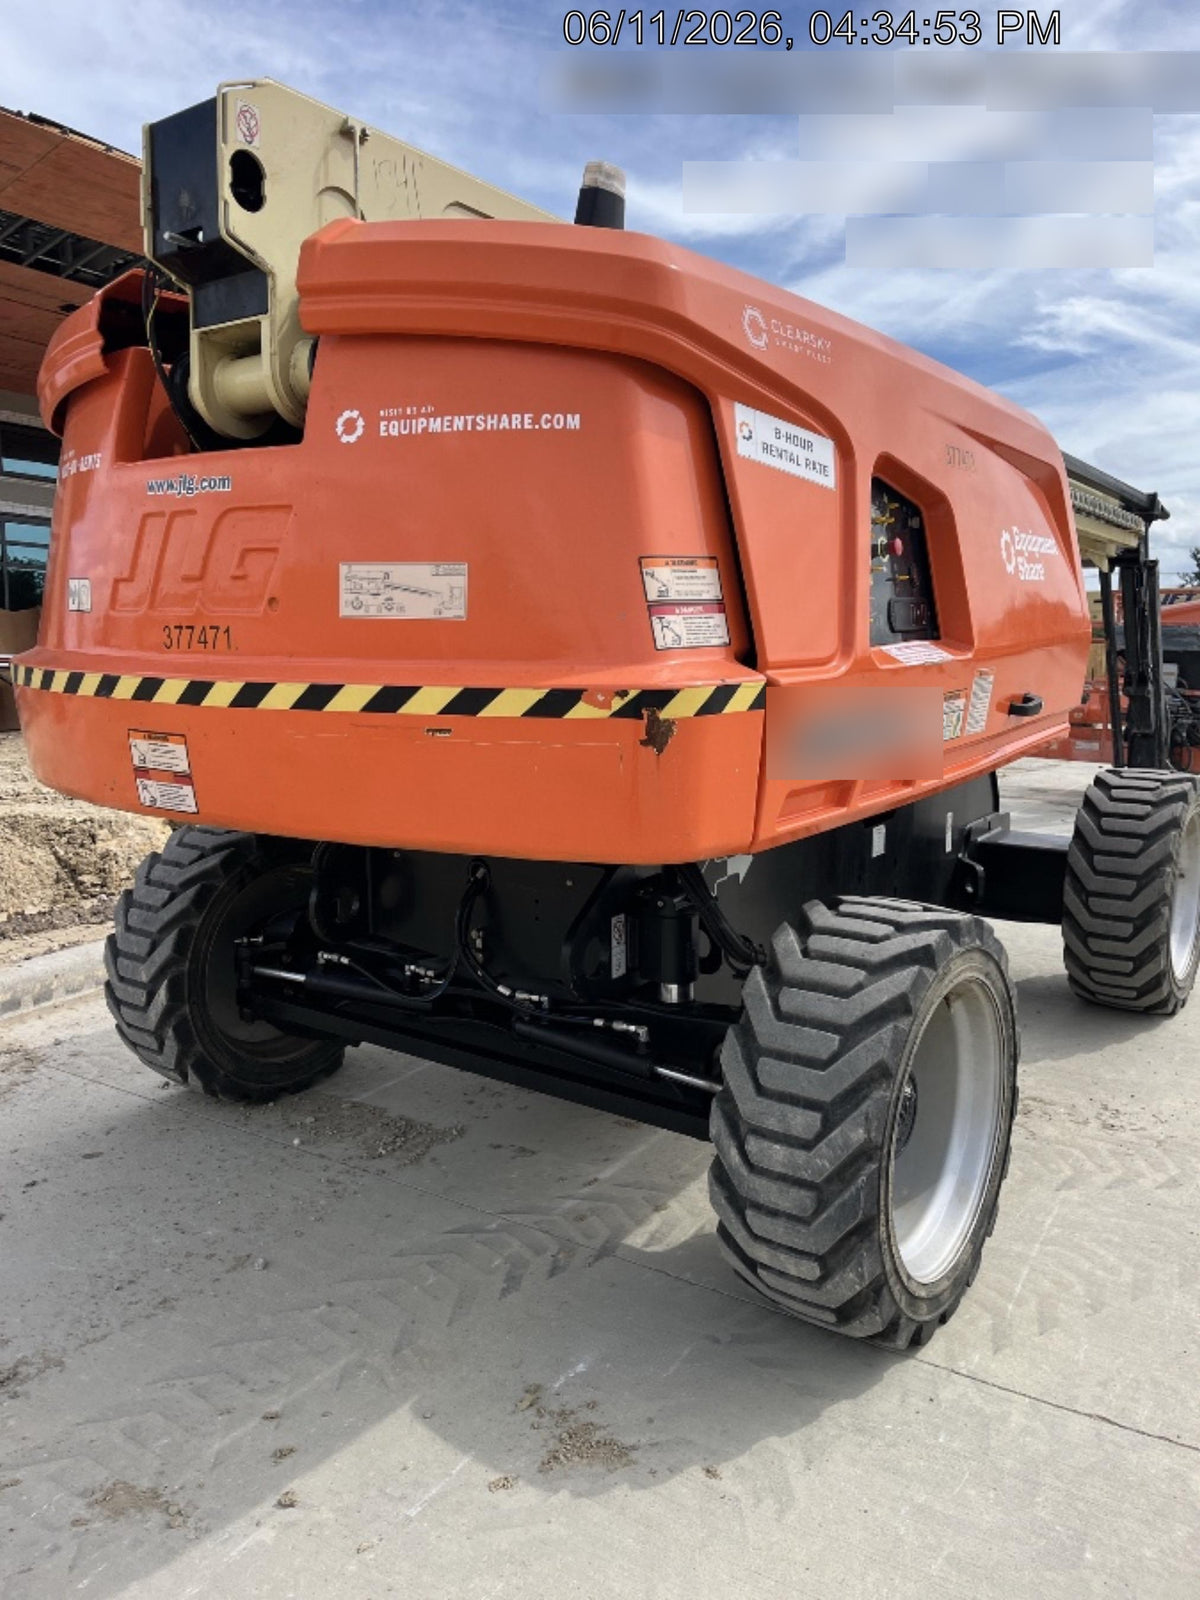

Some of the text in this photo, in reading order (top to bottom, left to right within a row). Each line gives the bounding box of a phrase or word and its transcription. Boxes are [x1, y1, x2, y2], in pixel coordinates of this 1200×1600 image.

[770, 318, 832, 350] CLEARSKY
[379, 412, 581, 437] EQUIPMENTSHARE.COM
[761, 441, 830, 478] RENTAL RATE
[147, 473, 232, 498] www.jlg.com
[109, 504, 293, 617] JLG
